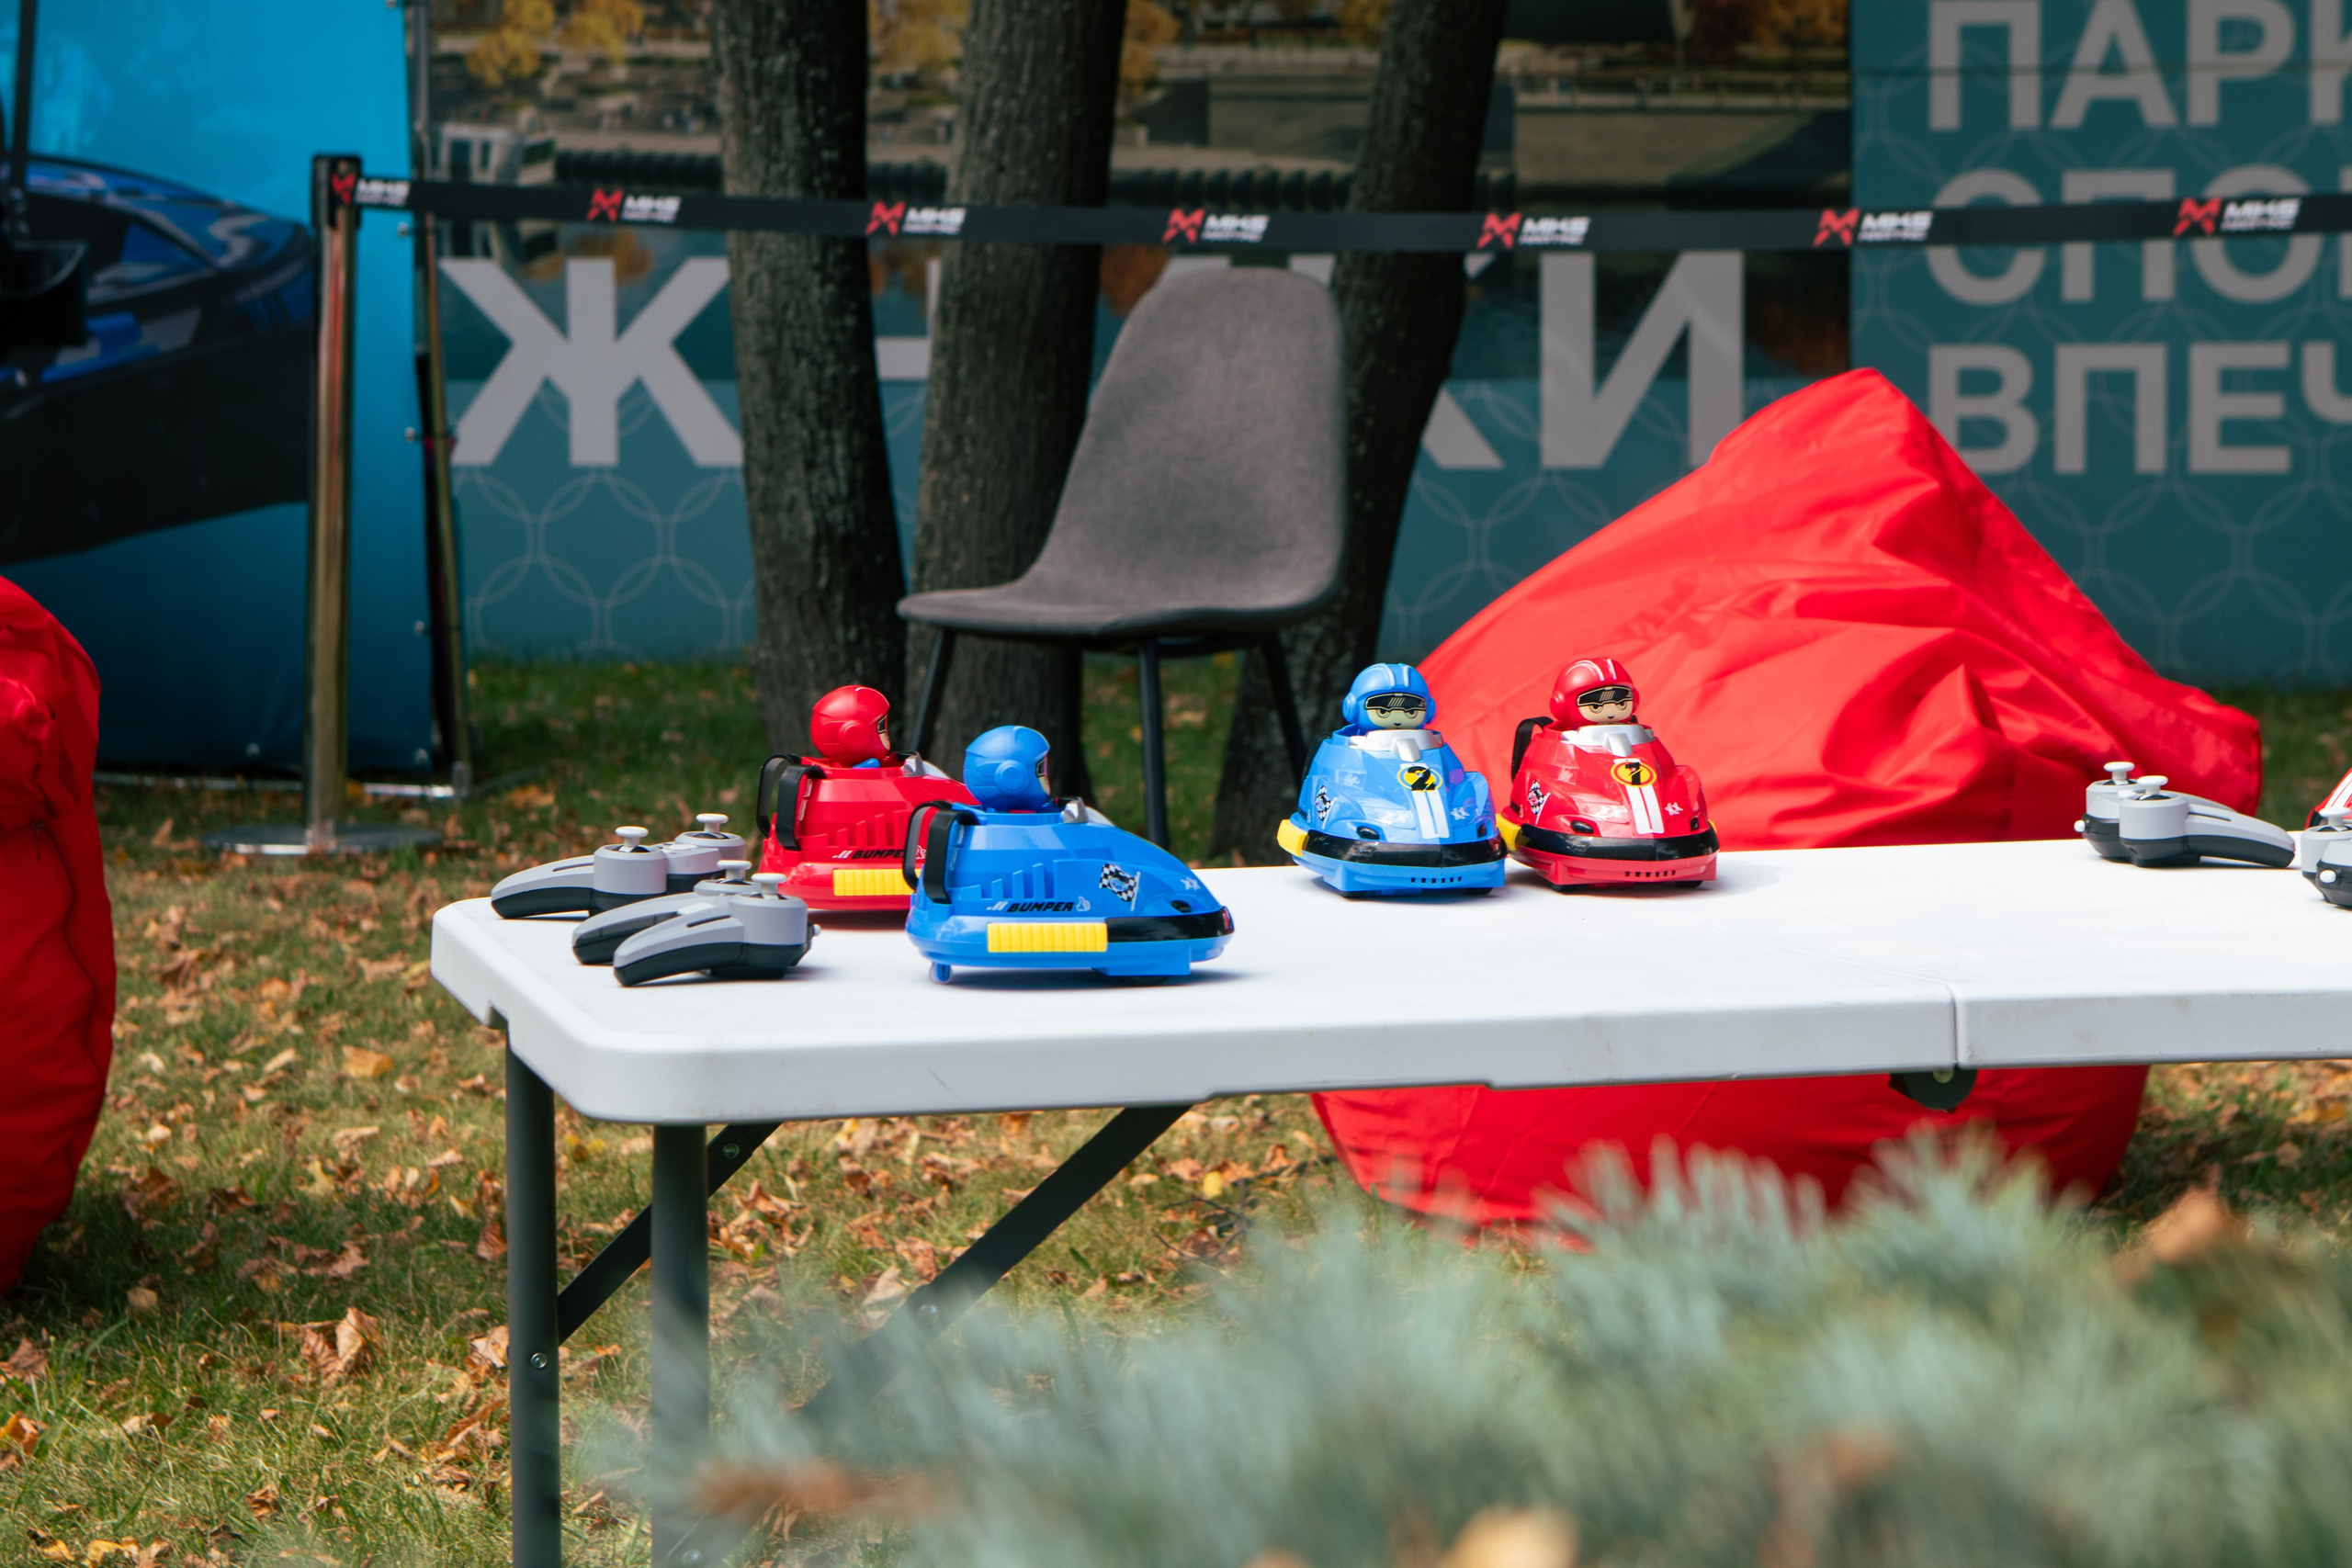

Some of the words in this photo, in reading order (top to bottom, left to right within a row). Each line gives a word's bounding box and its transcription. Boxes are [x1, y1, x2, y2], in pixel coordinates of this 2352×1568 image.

[1926, 164, 2352, 306] СПО
[1408, 765, 1436, 791] 2
[852, 850, 905, 859] BUMPE
[1007, 902, 1074, 912] BUMPER
